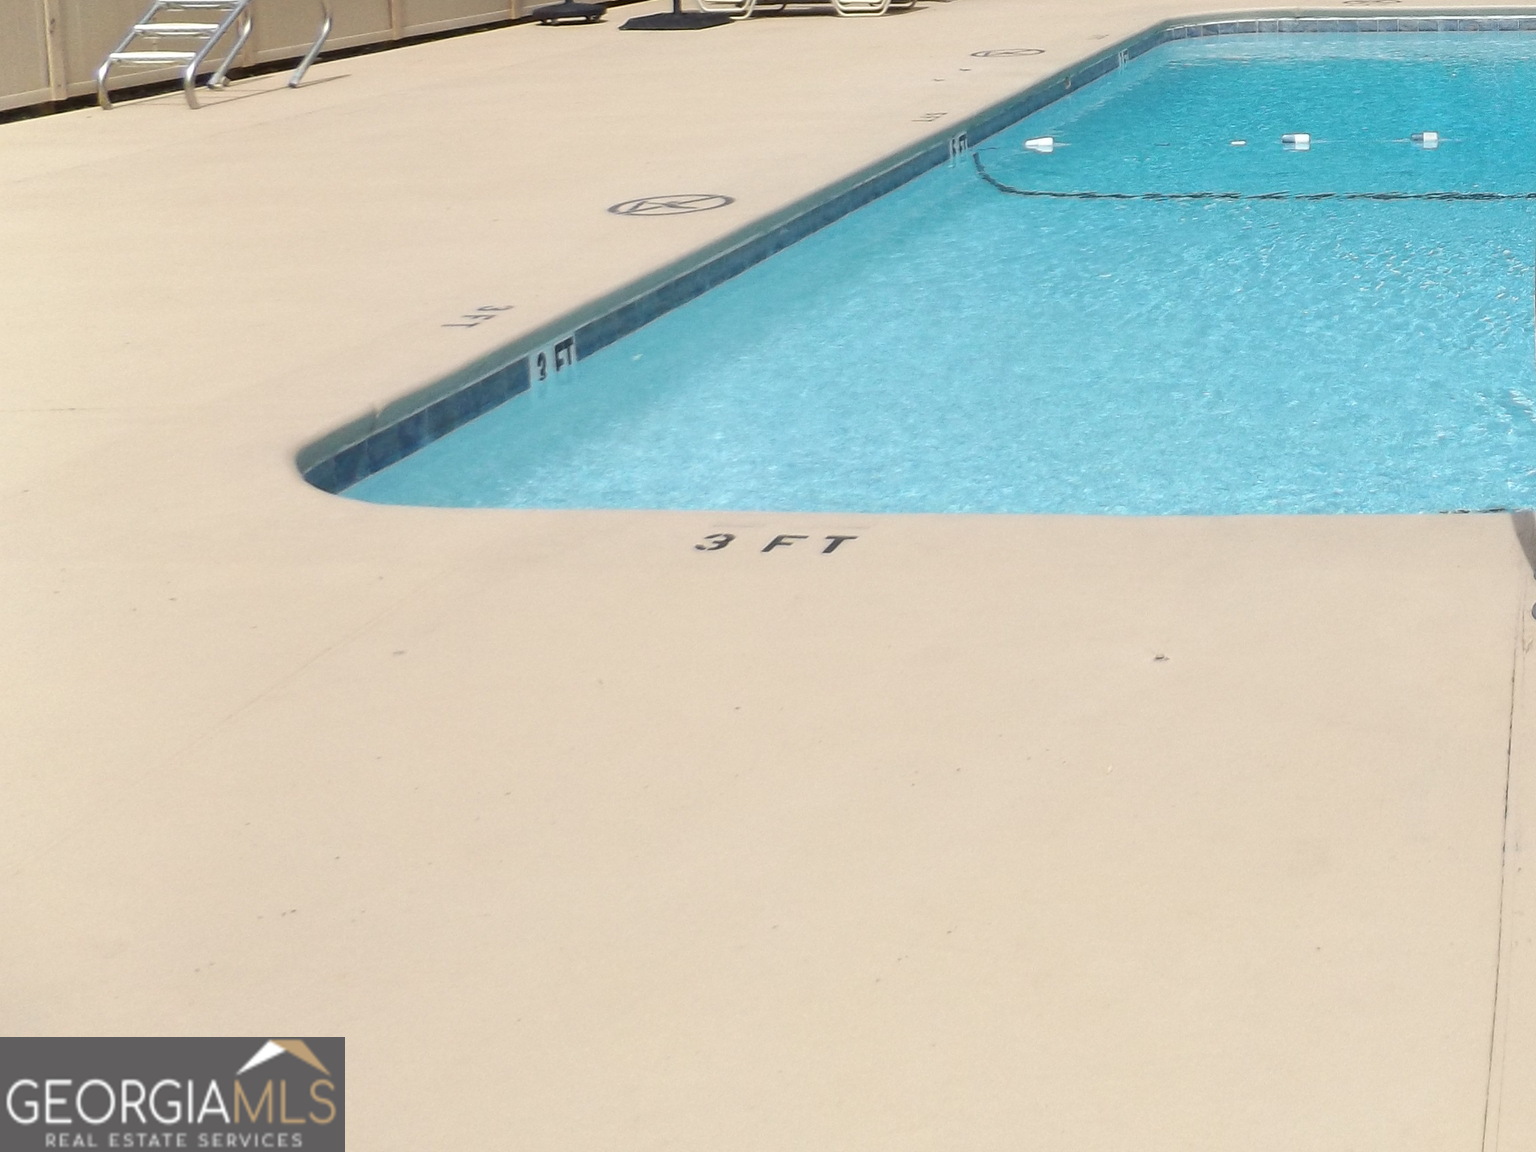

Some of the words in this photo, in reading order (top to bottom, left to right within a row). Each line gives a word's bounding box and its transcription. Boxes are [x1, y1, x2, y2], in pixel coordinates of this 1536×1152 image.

[536, 351, 547, 382] 3
[554, 335, 574, 372] FT
[694, 533, 736, 551] 3
[760, 534, 859, 554] FT
